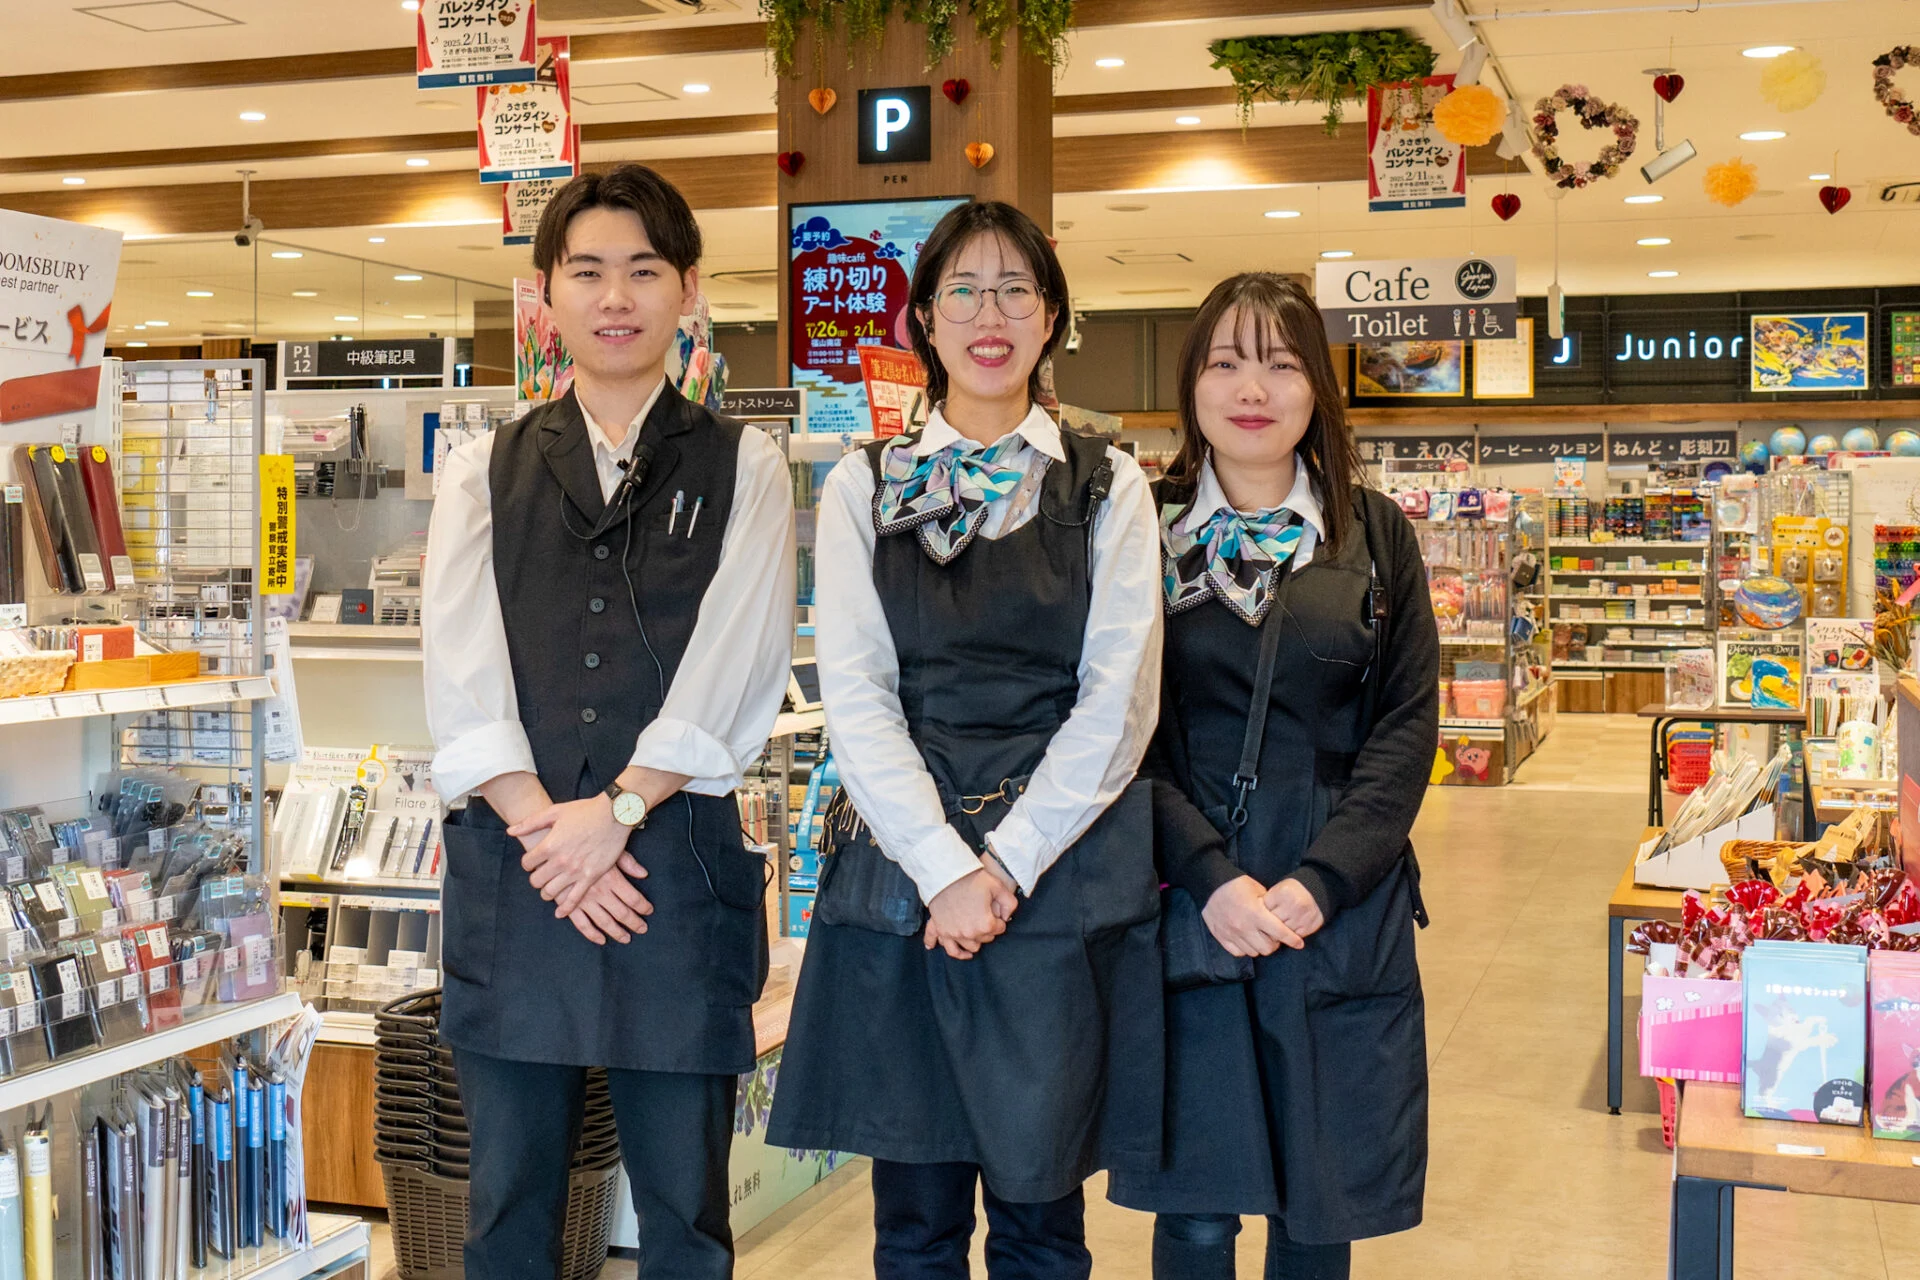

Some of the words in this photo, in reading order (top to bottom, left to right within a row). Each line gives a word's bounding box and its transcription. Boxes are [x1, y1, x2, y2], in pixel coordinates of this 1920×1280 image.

[439, 0, 508, 14] バレンタイン
[438, 13, 497, 28] コンサート
[507, 101, 538, 111] うさぎや
[495, 111, 550, 124] バレンタイン
[876, 98, 911, 152] P
[494, 123, 540, 136] コンサート
[1399, 137, 1431, 146] うさぎや
[1386, 146, 1444, 158] バレンタイン
[1385, 157, 1434, 169] コンサート
[883, 175, 908, 184] PEN
[517, 187, 559, 198] バレンタイ
[802, 231, 831, 242] 要予約
[826, 251, 866, 265] 趣味café
[0, 252, 90, 281] OMSBURY
[0, 275, 17, 288] est
[20, 278, 59, 294] partner
[802, 264, 888, 293] 練り切り
[1345, 266, 1430, 302] Cafe
[802, 292, 887, 315] アート体験
[1348, 311, 1429, 337] Toilet
[293, 345, 311, 358] P1
[1552, 336, 1572, 364] J
[1615, 330, 1744, 361] Junior
[346, 349, 416, 366] 中級筆記具
[293, 360, 311, 373] 12
[1358, 439, 1473, 460] 書道・えのぐ
[1480, 441, 1602, 459] クーピー・クレヨン
[1612, 438, 1730, 457] ねんど・彫刻刀
[275, 486, 289, 588] 特別警戒実施中
[394, 797, 427, 809] Filare
[730, 1168, 761, 1208] れ無料
